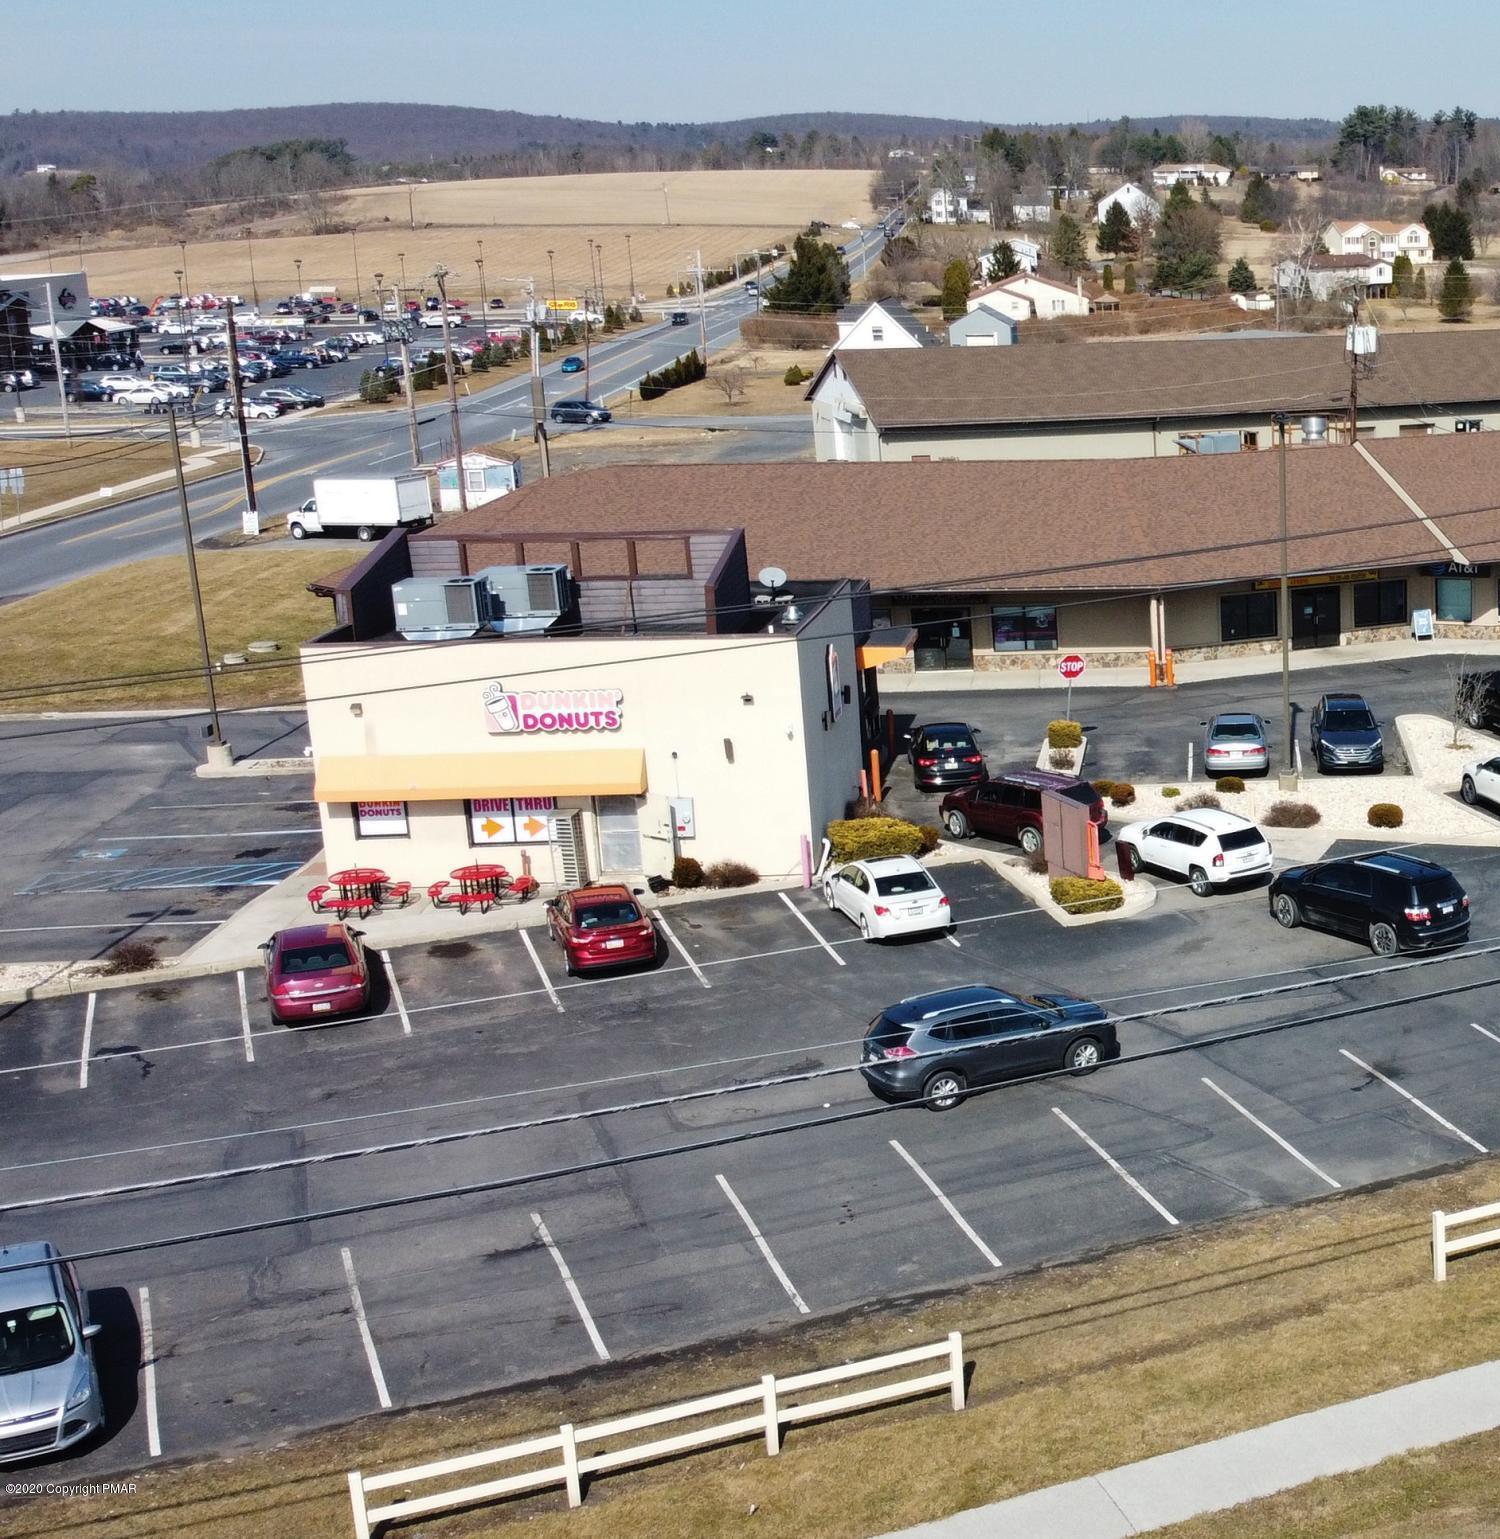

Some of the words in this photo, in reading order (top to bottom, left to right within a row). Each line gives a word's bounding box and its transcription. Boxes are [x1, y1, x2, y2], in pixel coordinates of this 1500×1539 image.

[1060, 661, 1084, 673] STOP
[520, 691, 621, 711] DUNKIN'
[522, 710, 618, 730] DONUTS
[359, 808, 402, 818] DONUTS
[473, 798, 510, 813] DRIVE
[516, 797, 552, 812] THRU
